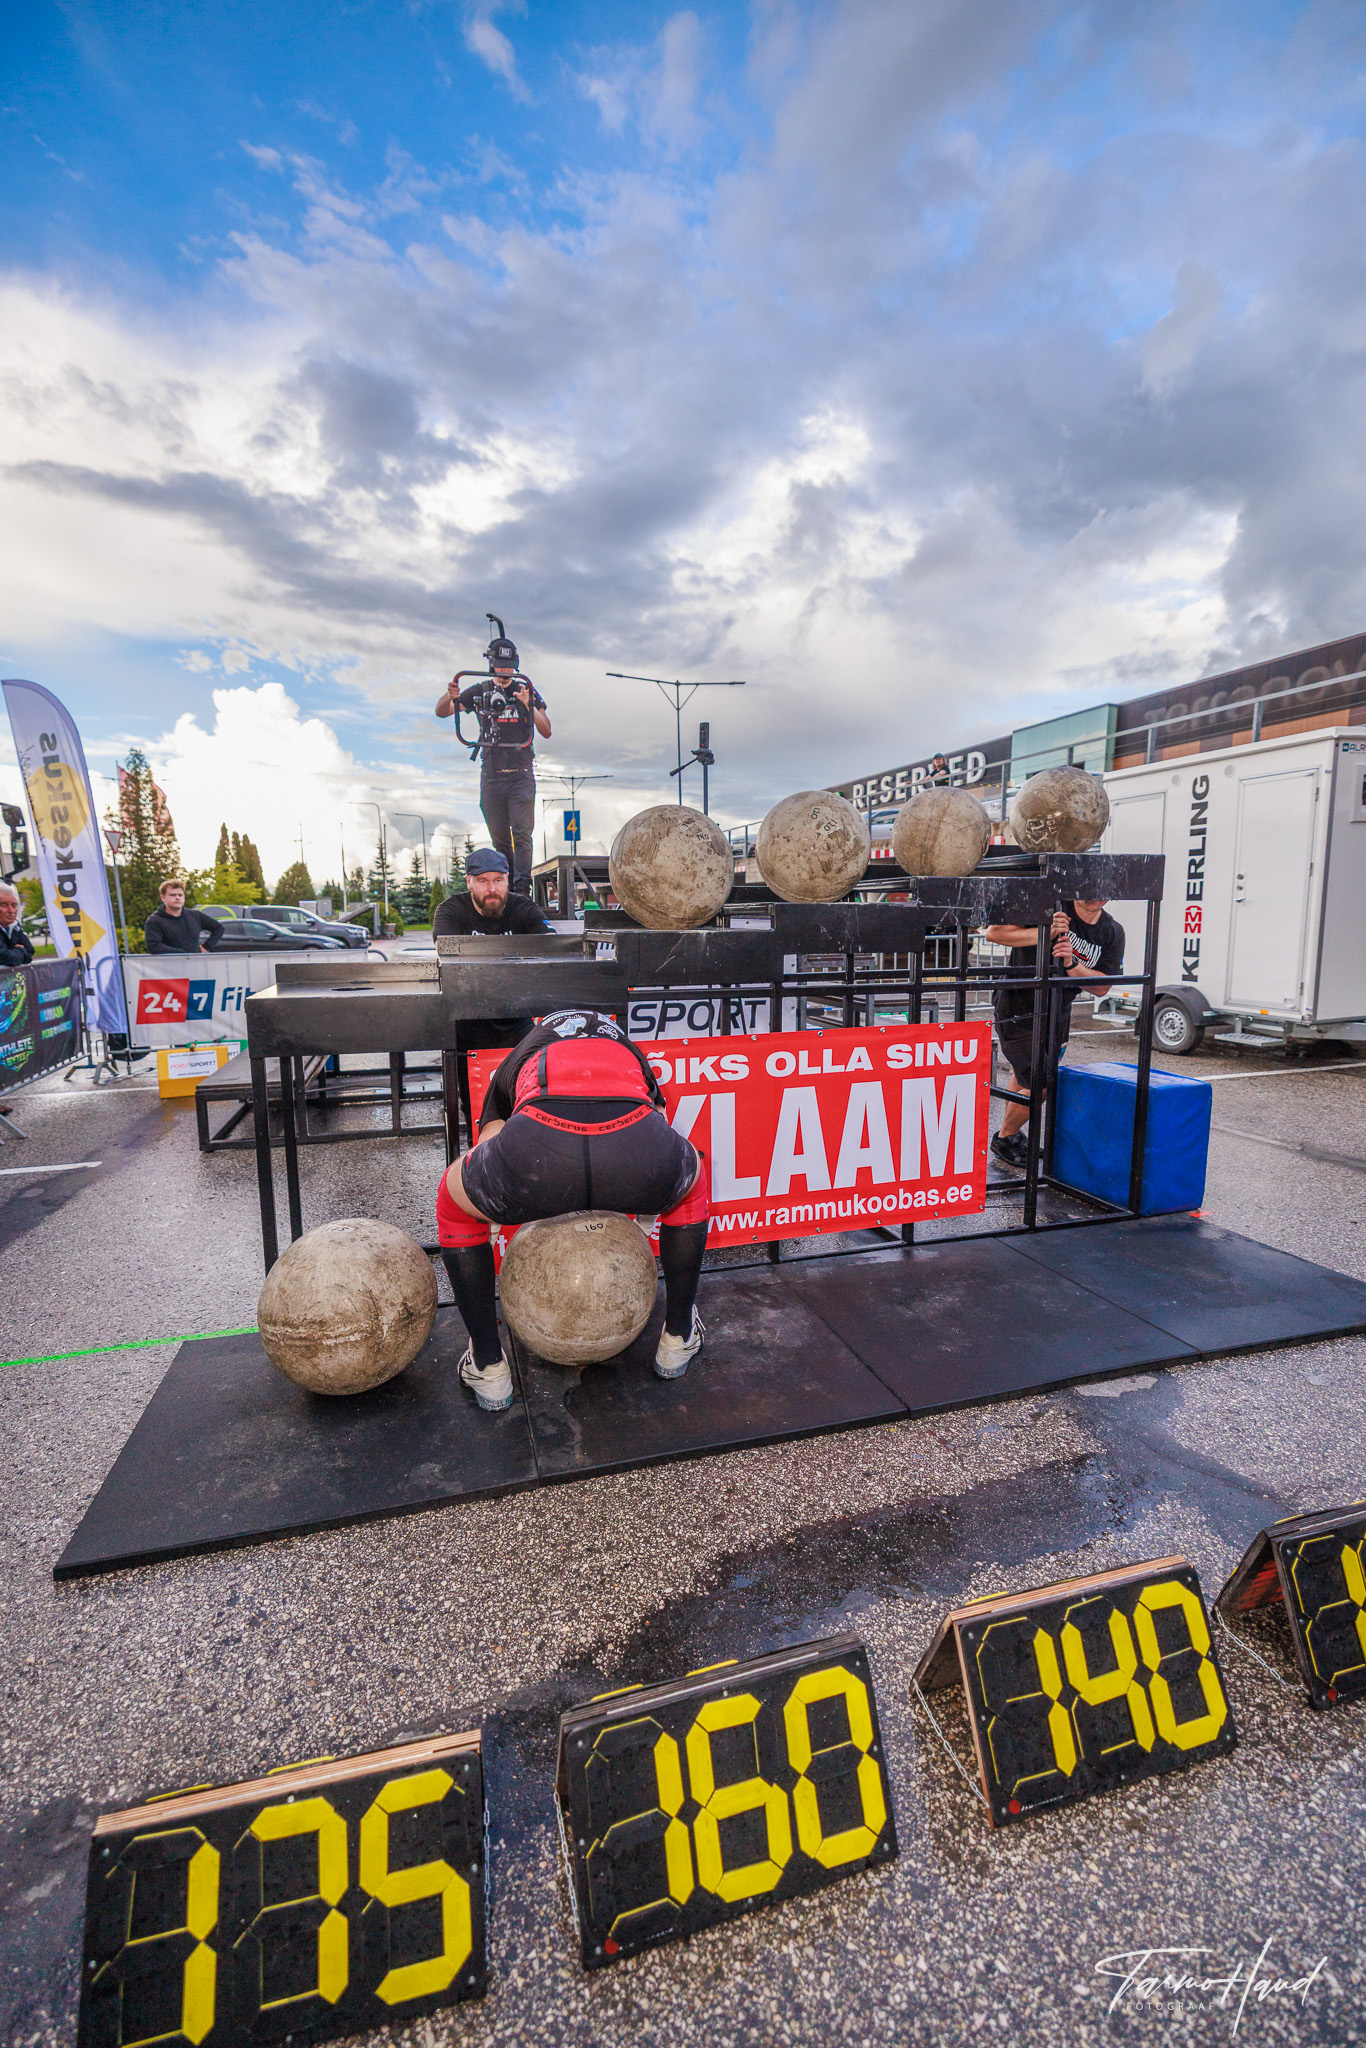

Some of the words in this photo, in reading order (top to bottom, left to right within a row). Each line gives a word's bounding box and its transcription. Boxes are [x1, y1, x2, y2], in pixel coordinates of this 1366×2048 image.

[566, 818, 578, 833] 4
[823, 818, 838, 832] 120
[143, 992, 182, 1013] 24
[193, 993, 208, 1011] 7
[647, 1052, 750, 1087] ÕIKS
[765, 1046, 873, 1077] OLLA
[886, 1039, 978, 1069] SINU
[584, 1222, 604, 1232] 160
[707, 1184, 973, 1234] ww.rammukoobas.ee
[1033, 1580, 1228, 1777] 140
[654, 1665, 887, 1905] 160
[181, 1768, 472, 2046] 175
